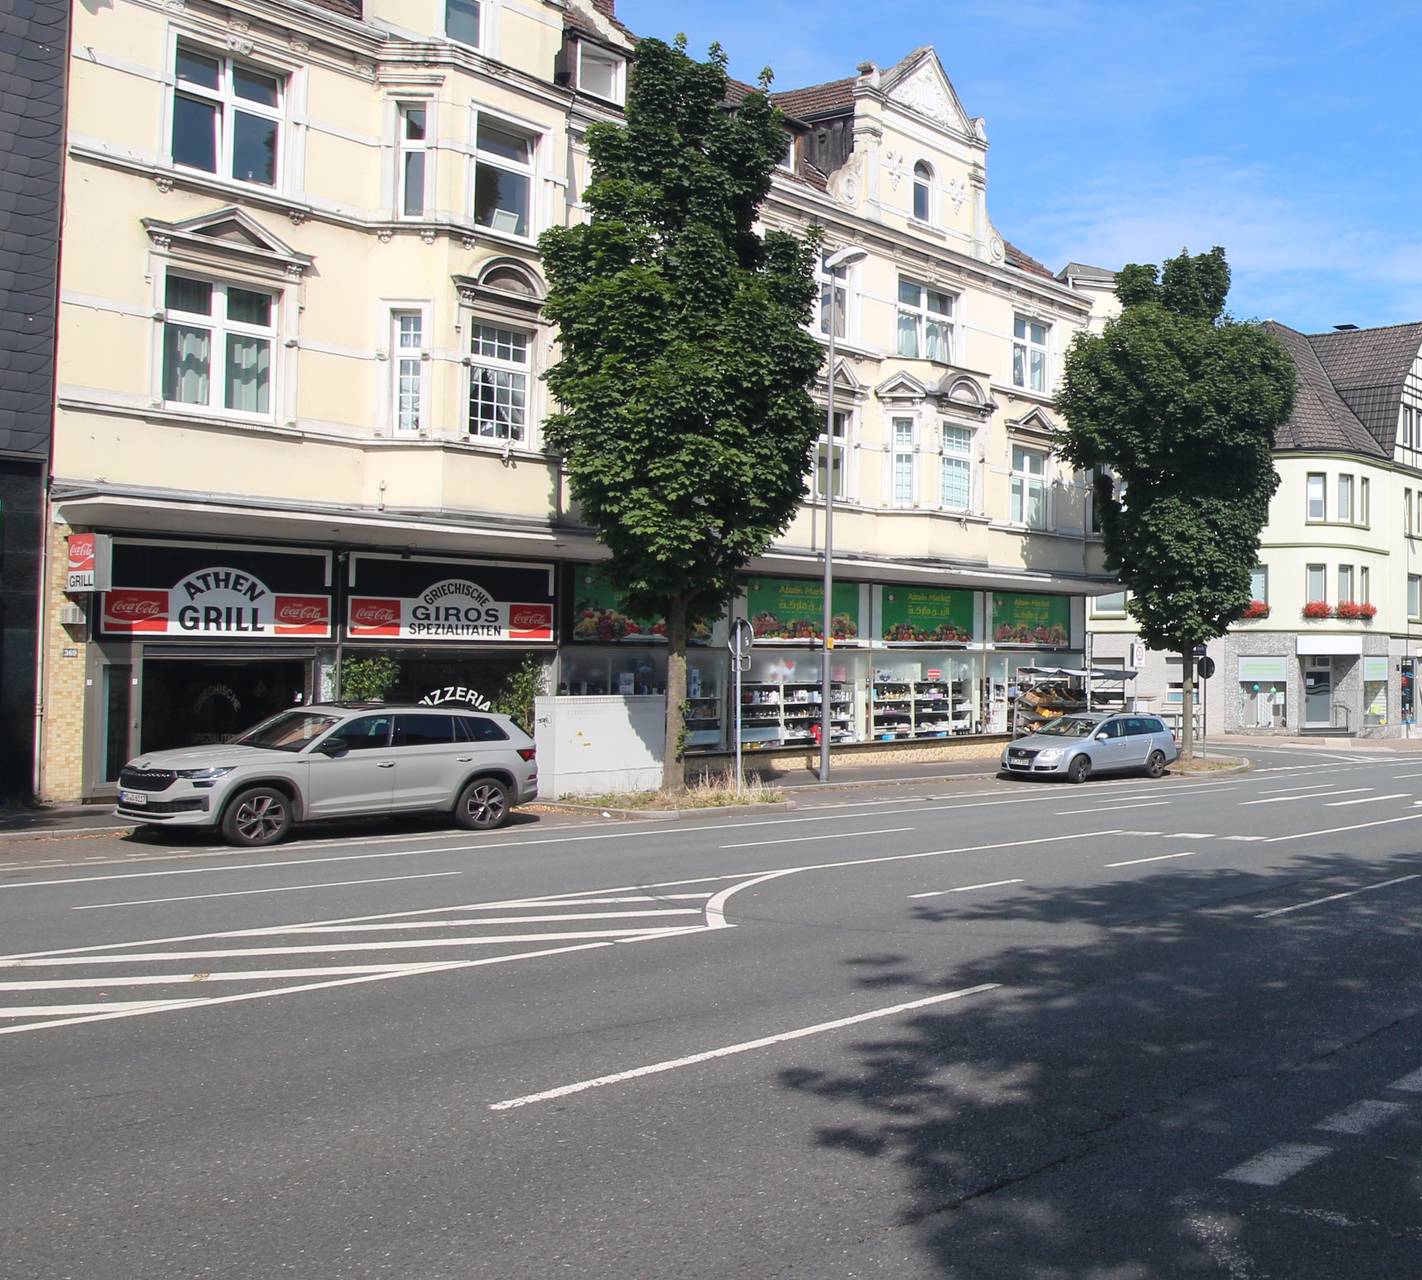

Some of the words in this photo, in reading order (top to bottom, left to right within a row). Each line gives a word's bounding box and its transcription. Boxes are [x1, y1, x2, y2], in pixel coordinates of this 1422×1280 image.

[69, 575, 93, 587] GRILL
[183, 571, 267, 602] ATHEN
[424, 583, 490, 607] GRIECHISCHE
[178, 605, 265, 632] GRILL
[411, 605, 499, 623] GIROS
